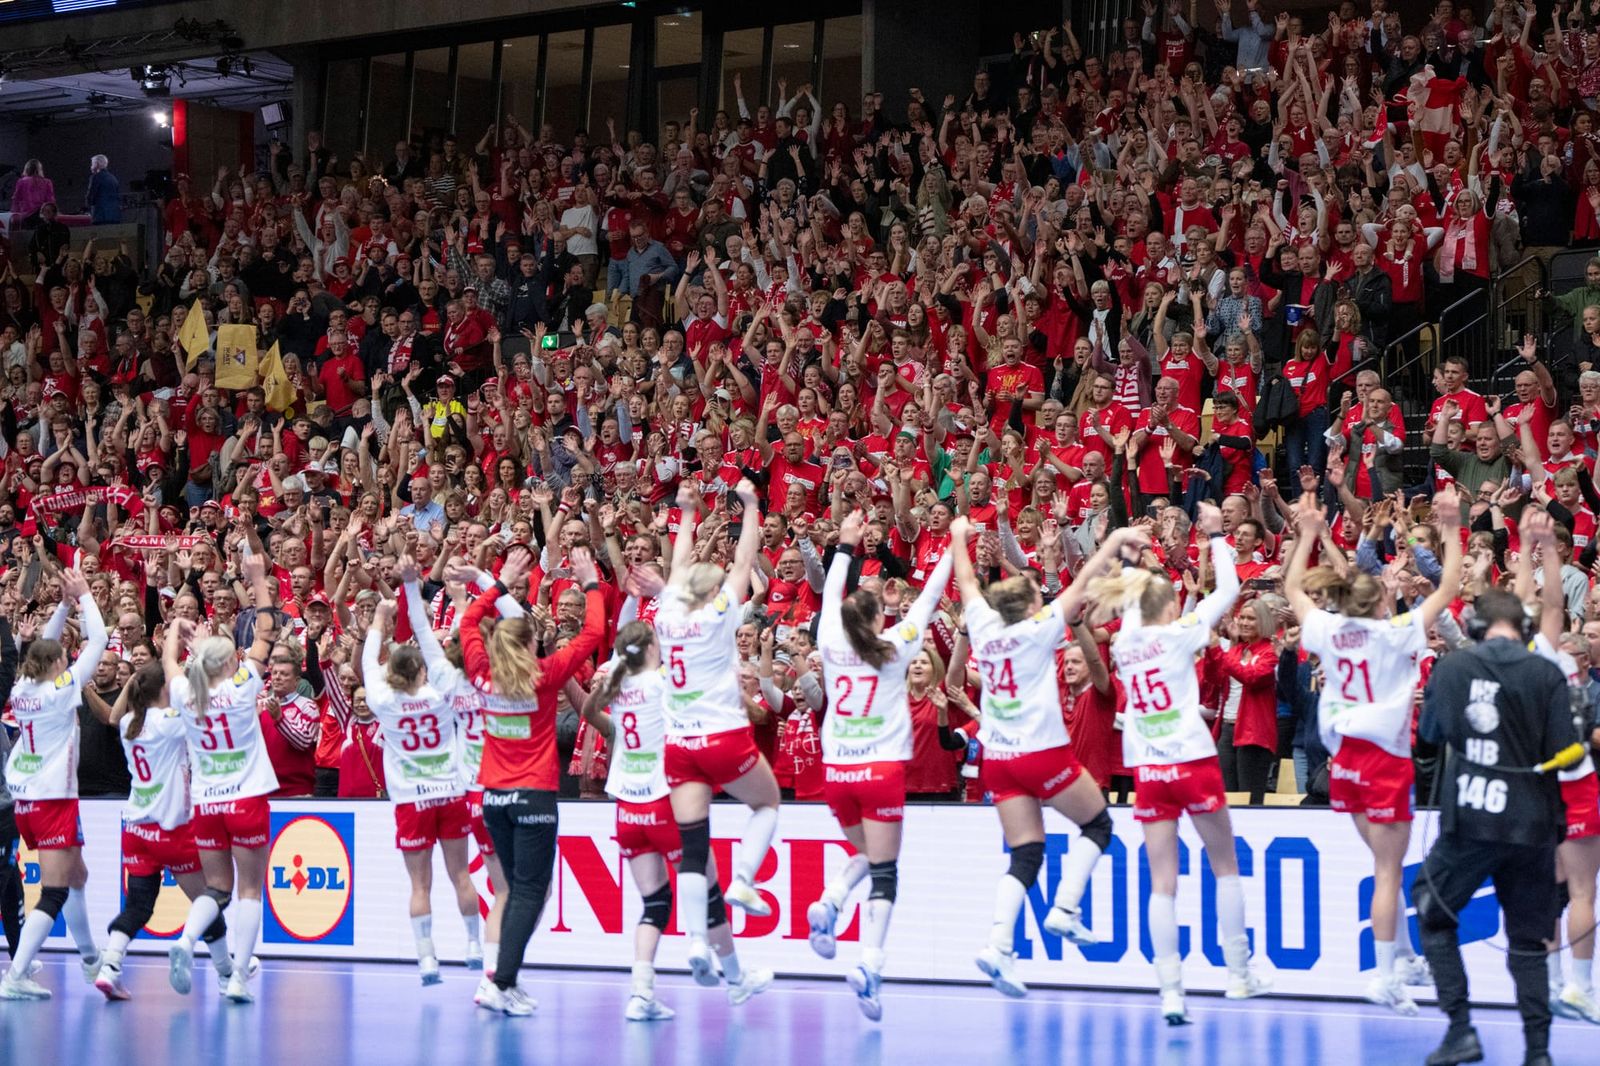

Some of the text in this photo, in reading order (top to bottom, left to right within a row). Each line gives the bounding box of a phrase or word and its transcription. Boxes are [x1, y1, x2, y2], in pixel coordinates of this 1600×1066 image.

[129, 536, 200, 546] DANMRK
[671, 646, 686, 688] 5
[982, 658, 1018, 698] 34
[1338, 659, 1374, 703] 21
[836, 675, 879, 717] 27
[1131, 668, 1172, 713] 45
[195, 713, 234, 750] 31
[399, 714, 440, 750] 33
[622, 712, 641, 749] 8
[133, 745, 152, 782] 6
[215, 759, 247, 774] bring
[1466, 738, 1499, 766] HB
[826, 767, 873, 783] Boozt
[1456, 774, 1509, 813] 146
[518, 814, 557, 824] FASHION
[272, 854, 345, 895] LIDL
[1003, 833, 1320, 971] NOCCO
